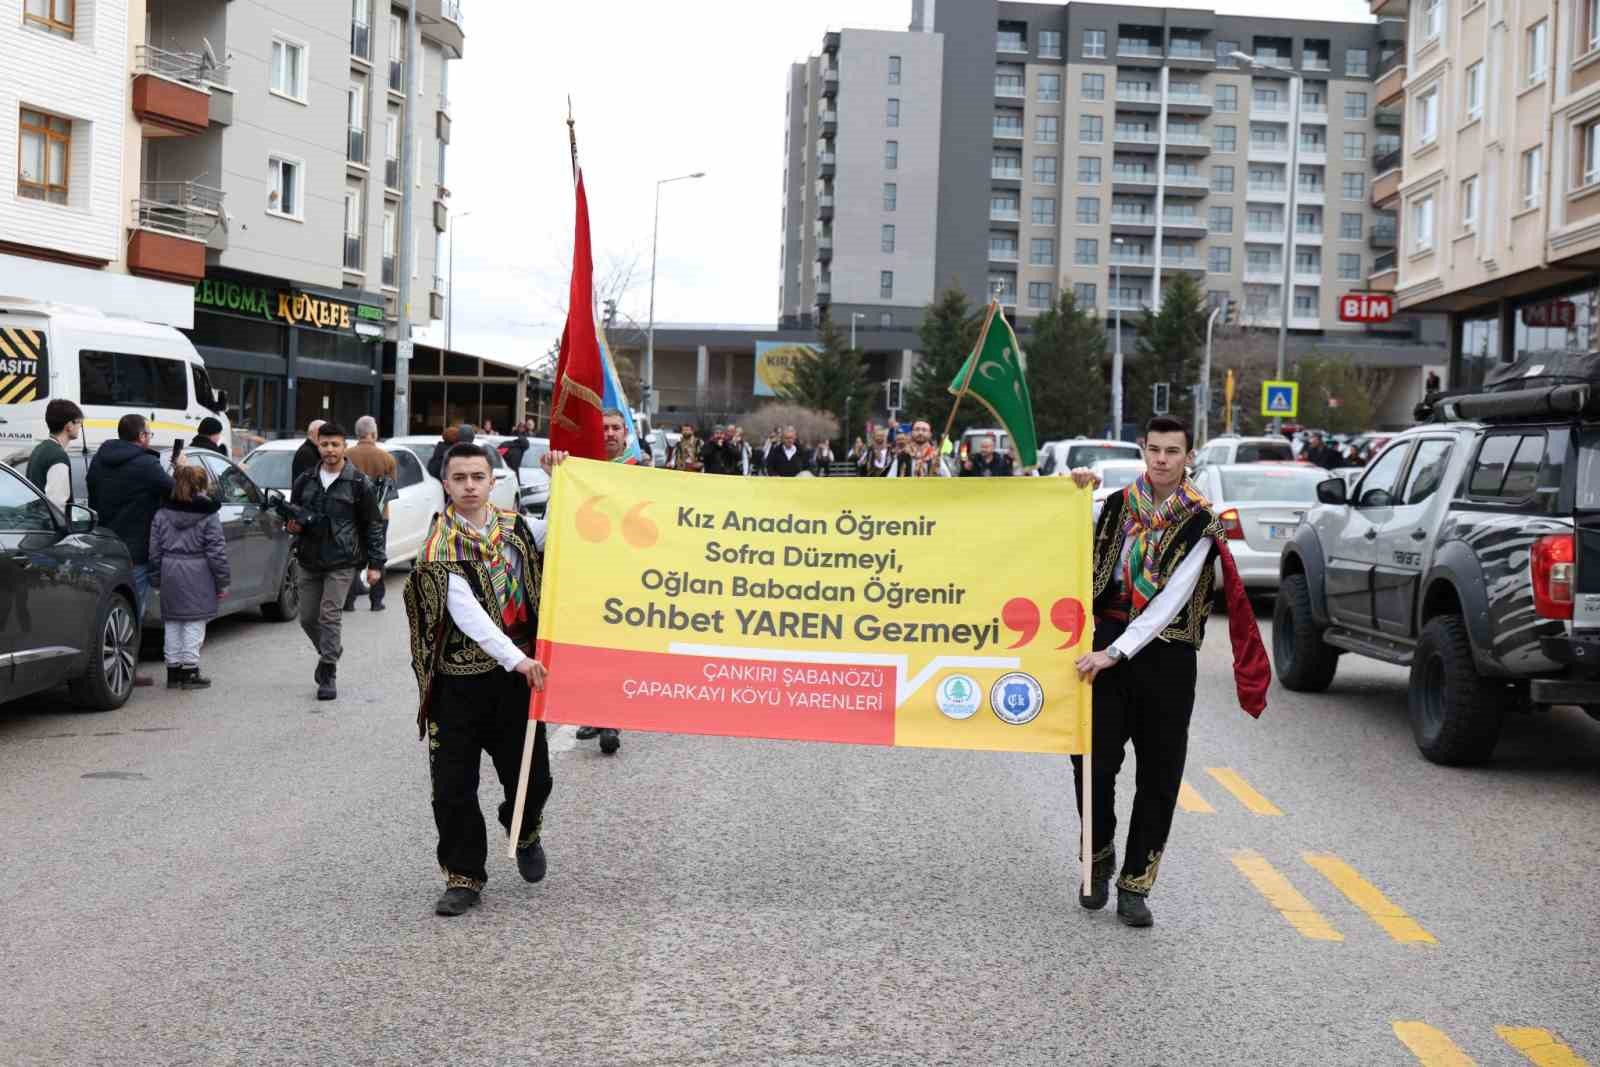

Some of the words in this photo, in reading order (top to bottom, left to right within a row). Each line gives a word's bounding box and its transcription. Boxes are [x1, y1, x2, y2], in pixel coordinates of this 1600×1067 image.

[677, 506, 715, 529] Kız
[722, 511, 827, 535] Anadan
[835, 510, 936, 541] Öğrenir
[705, 541, 775, 566] Sofra
[784, 546, 903, 574] Düzmeyi,
[641, 569, 723, 598] Oğlan
[732, 576, 855, 602] Babadan
[863, 577, 965, 609] Öğrenir
[603, 597, 725, 634] Sohbet
[736, 609, 843, 640] YAREN
[854, 614, 1000, 651] Gezmeyi
[703, 663, 777, 682] ÇANKIRI
[783, 668, 884, 688] ŞABANÖZÜ
[623, 679, 725, 703] ÇAPARKAYI
[731, 687, 781, 705] KÖYÜ
[786, 691, 883, 710] YARENLERİ
